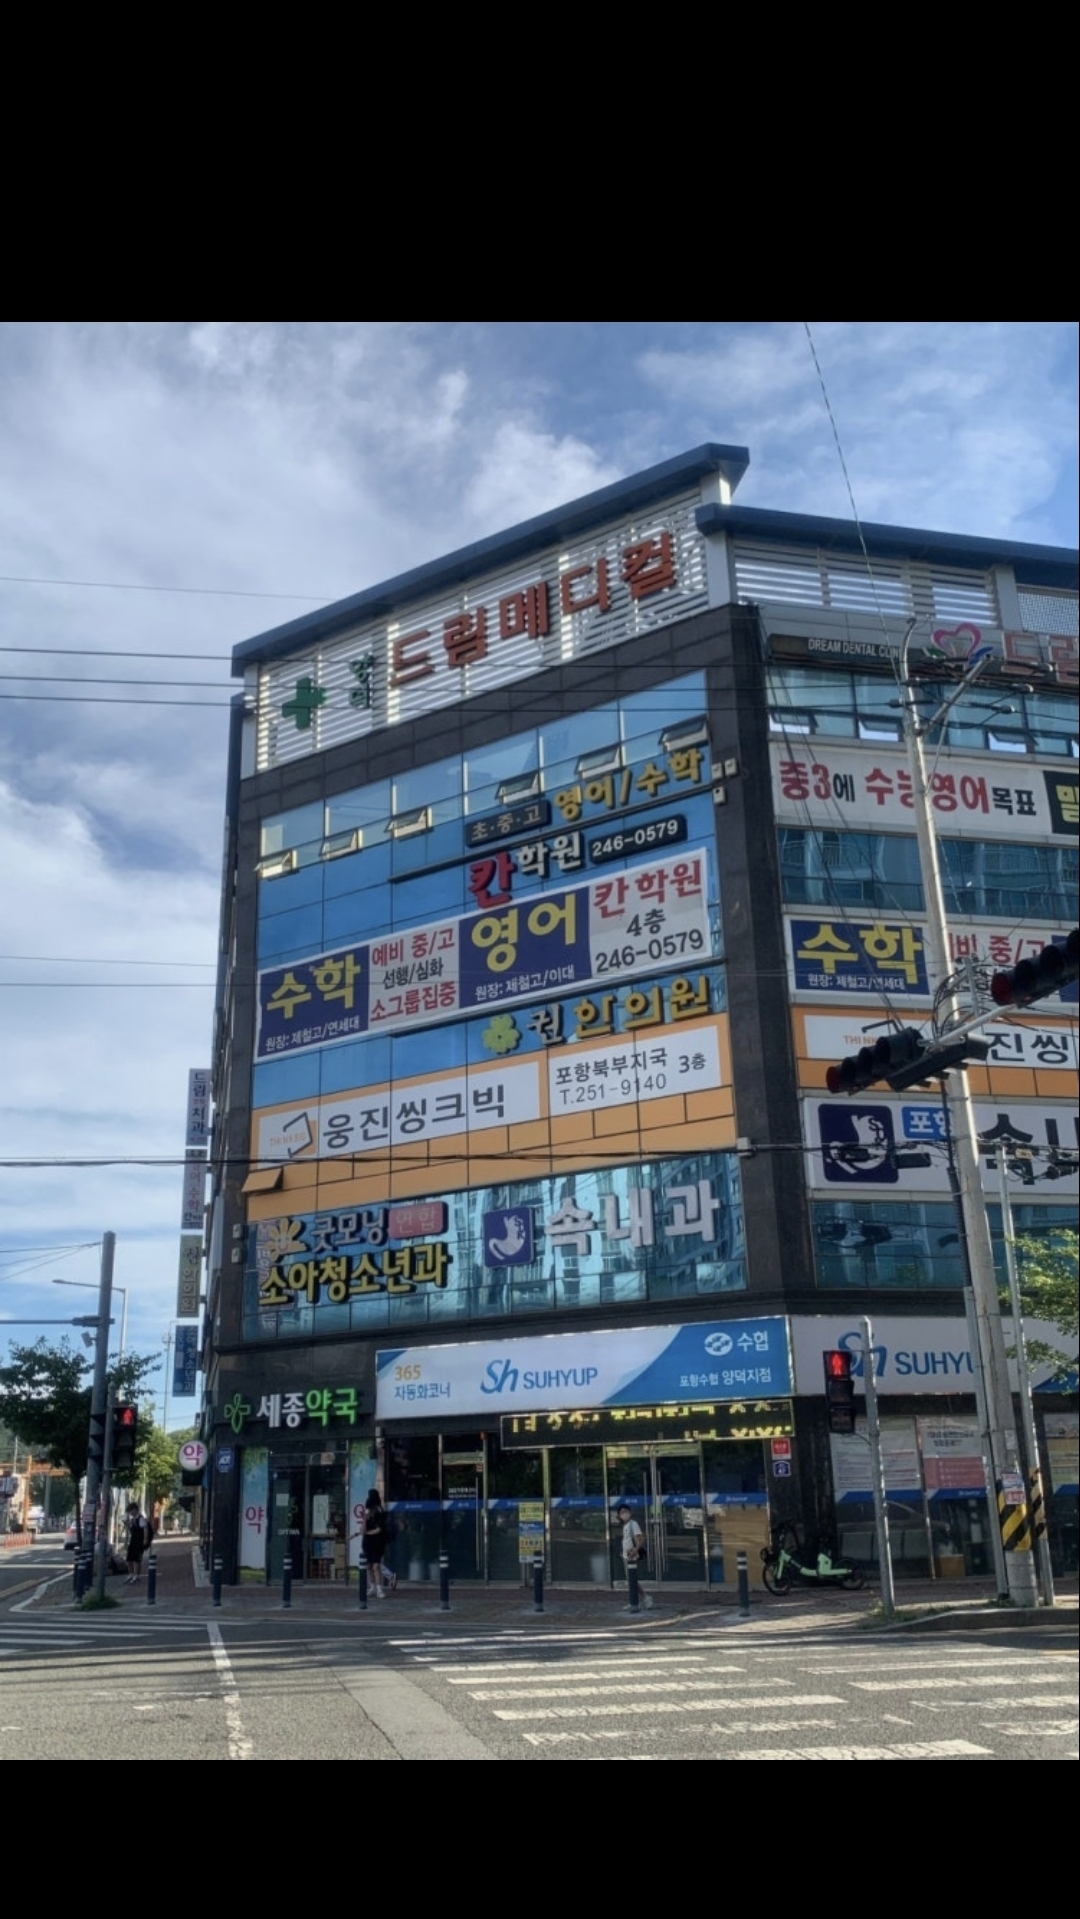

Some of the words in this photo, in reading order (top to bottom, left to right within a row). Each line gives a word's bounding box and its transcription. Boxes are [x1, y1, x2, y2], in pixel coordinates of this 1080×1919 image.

[390, 531, 677, 688] 드림메디컬
[808, 638, 840, 653] DREAM
[842, 642, 877, 657] DENTAL
[553, 747, 705, 820] 영어/수학
[779, 761, 856, 802] 중3에
[992, 786, 1037, 816] 목표
[592, 819, 679, 857] 246-0579
[470, 893, 578, 973] 영어
[626, 907, 666, 937] 4층
[371, 940, 404, 967] 예비
[412, 928, 456, 959] 중/고
[595, 930, 704, 974] 246-0579
[797, 923, 922, 984] 수학
[266, 953, 361, 1019] 수학
[381, 957, 443, 990] 선행/심화
[474, 980, 503, 1003] 원장:
[505, 967, 576, 995] 제철고/이대
[369, 980, 457, 1023] 소그룹집중
[265, 1035, 290, 1052] 원장:
[291, 1015, 361, 1045] 제철고/연세대
[985, 1031, 1069, 1065] 진씽
[556, 1047, 668, 1086] 포항북부지국
[678, 1053, 707, 1074] 3층
[560, 1073, 667, 1105] T.251-9140
[322, 1084, 505, 1149] 웅진씽크빅
[311, 1208, 386, 1253] 굿모닝
[395, 1206, 438, 1234] 연합
[544, 1179, 720, 1257] 속내과
[258, 1242, 449, 1306] 소아청소년과
[737, 1331, 770, 1353] 수협
[394, 1382, 451, 1400] 자동화코너
[395, 1364, 421, 1381] 365
[481, 1359, 518, 1394] Sh
[523, 1367, 598, 1390] SUHYUP
[721, 1366, 772, 1386] 양덕지점
[256, 1387, 358, 1428] 세종약국
[183, 1444, 204, 1466] 약
[245, 1506, 265, 1534] 약
